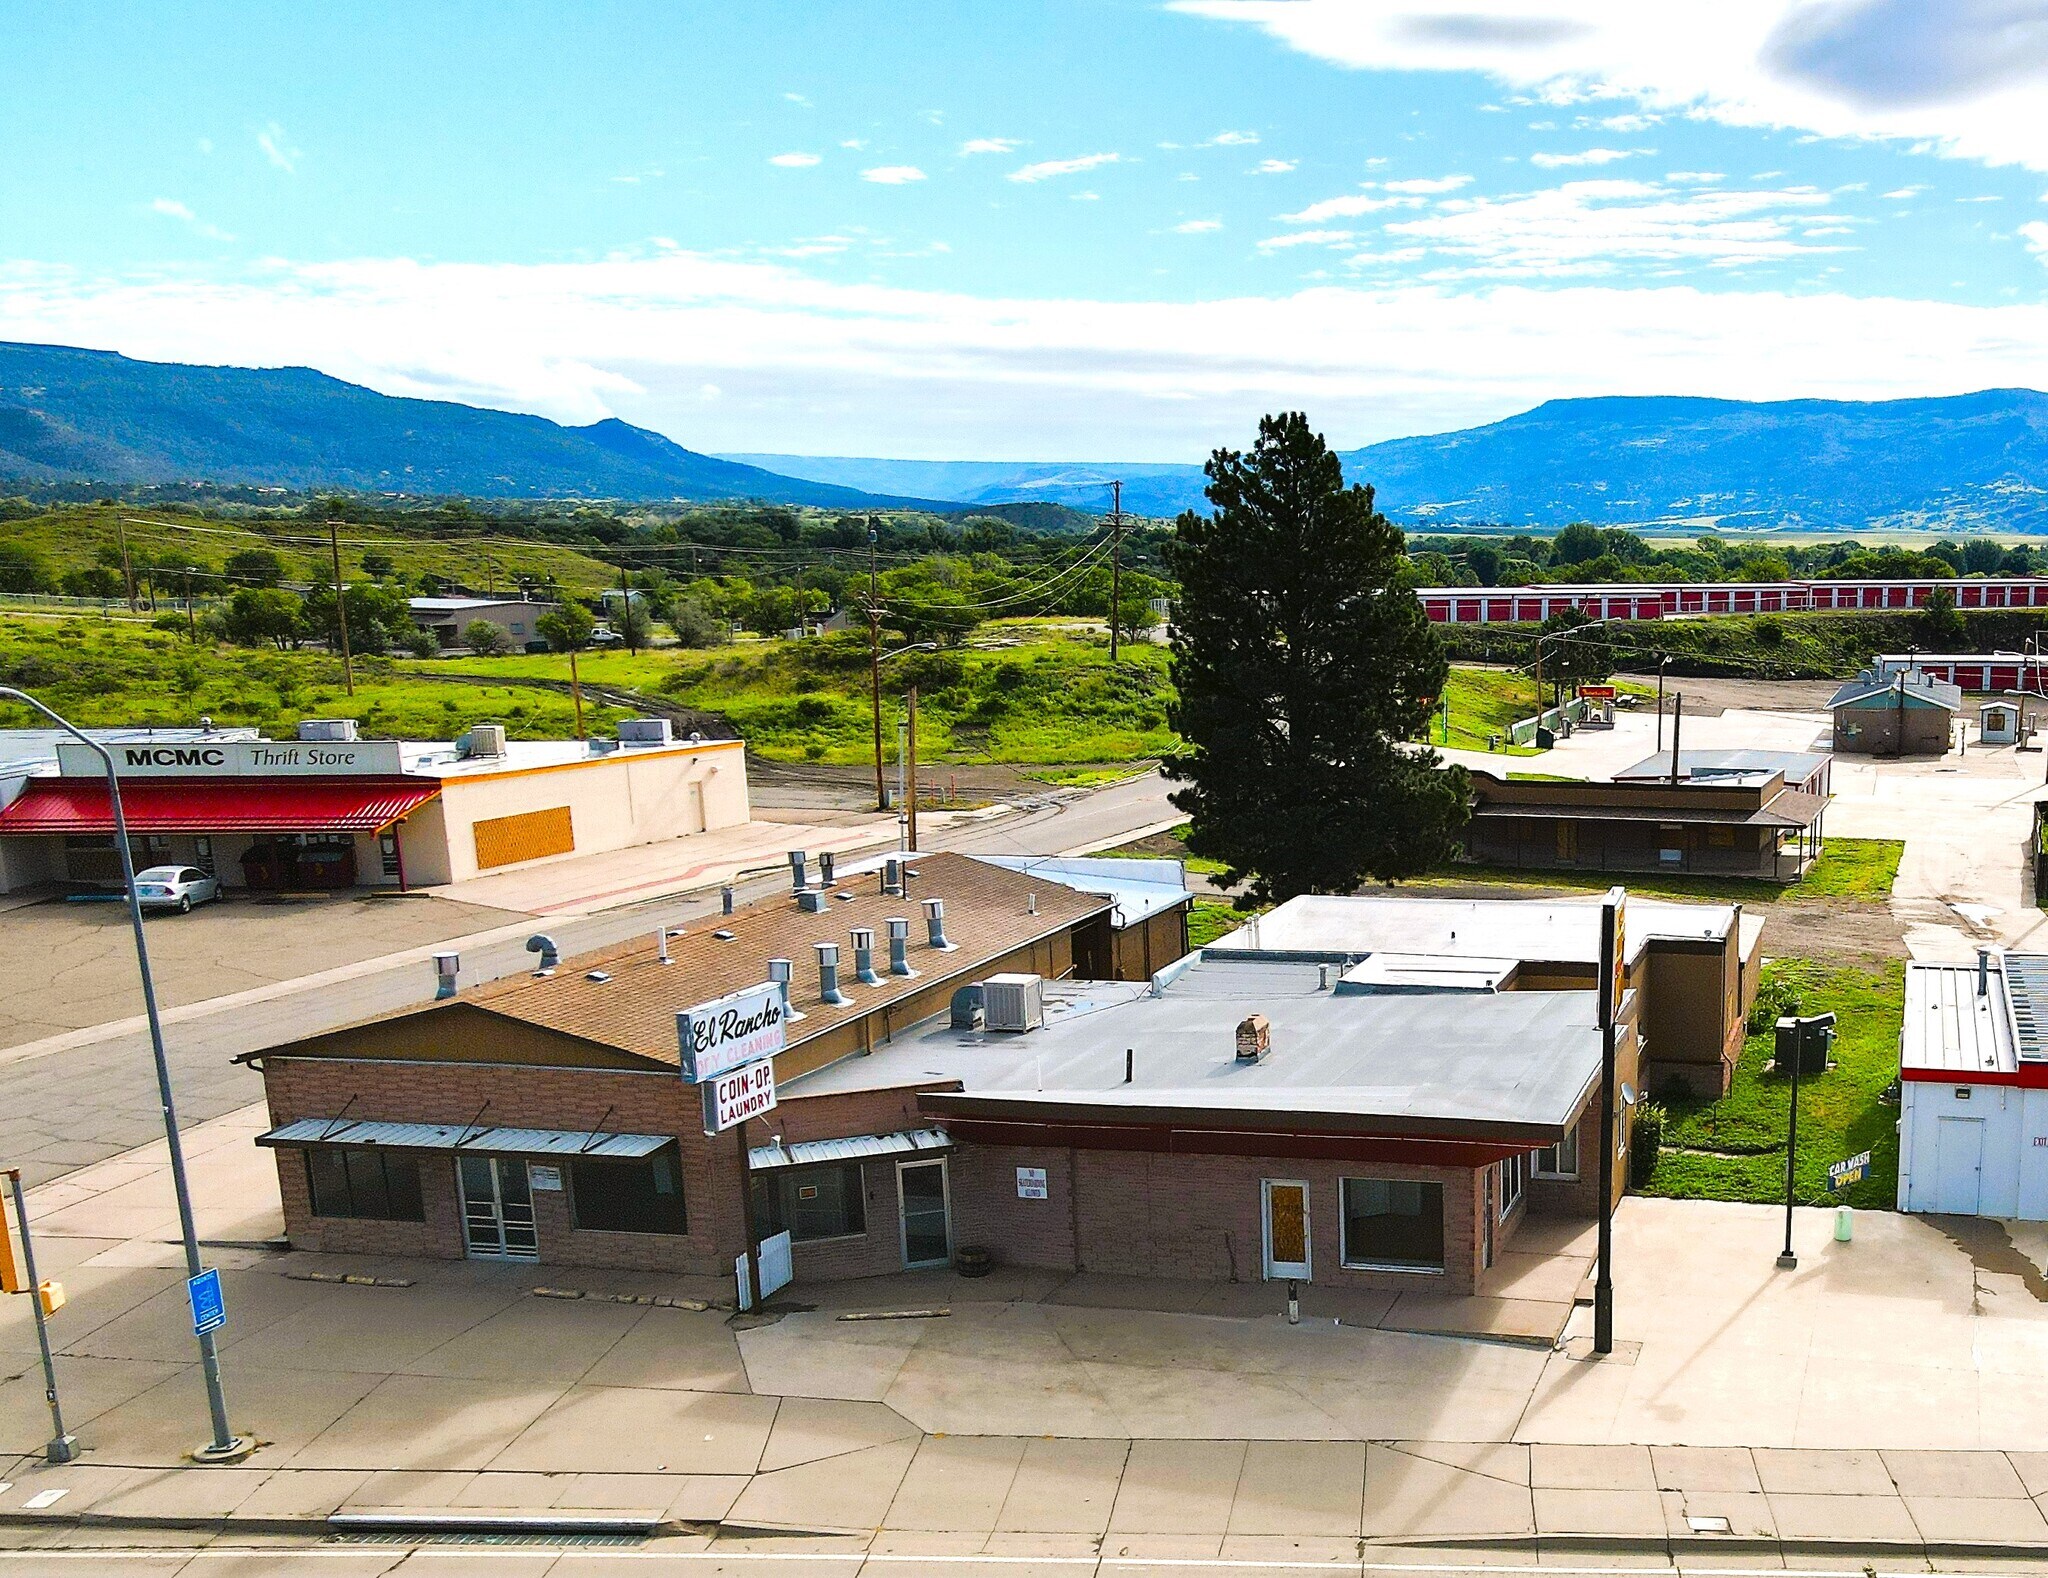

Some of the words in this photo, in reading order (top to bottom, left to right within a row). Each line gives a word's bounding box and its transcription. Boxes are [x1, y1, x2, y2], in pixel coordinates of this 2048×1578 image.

[126, 749, 225, 766] MCMC
[251, 748, 300, 766] Thrift
[307, 749, 355, 765] Store
[693, 1016, 717, 1053] El
[719, 998, 781, 1044] Rancho
[727, 1029, 781, 1063] CLEANING
[720, 1090, 771, 1124] LAUNDRY
[1829, 1162, 1846, 1177] CAR
[1847, 1150, 1870, 1170] WASH
[1835, 1167, 1862, 1188] OPEN
